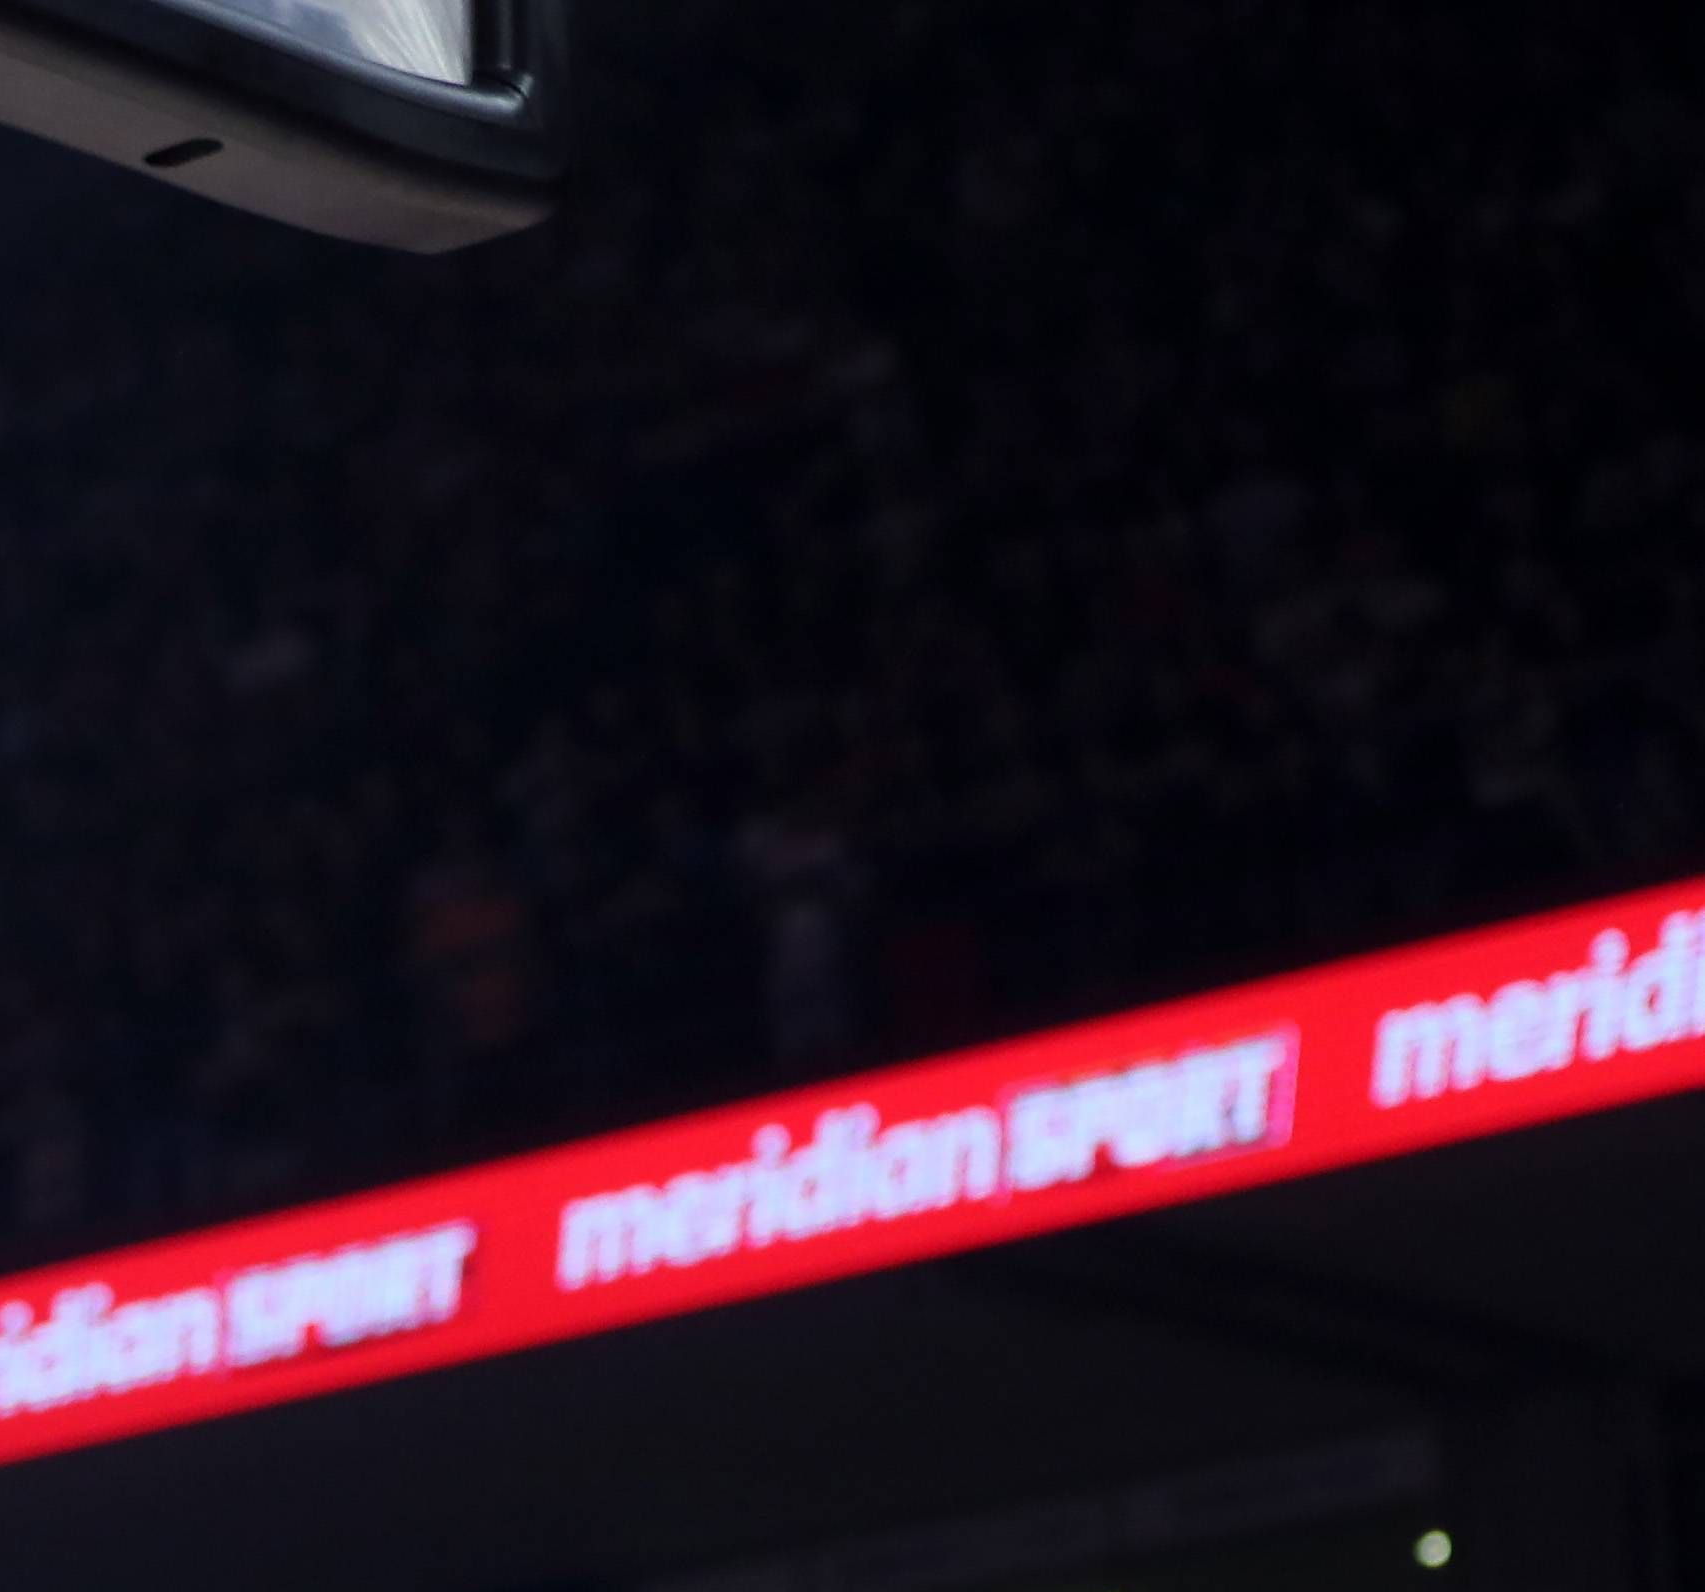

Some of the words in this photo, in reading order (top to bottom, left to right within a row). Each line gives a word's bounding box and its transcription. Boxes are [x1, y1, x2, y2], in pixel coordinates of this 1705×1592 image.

[555, 1102, 998, 1292] meridian
[1001, 1032, 1293, 1190] SPORT
[223, 1220, 477, 1367] SPORT
